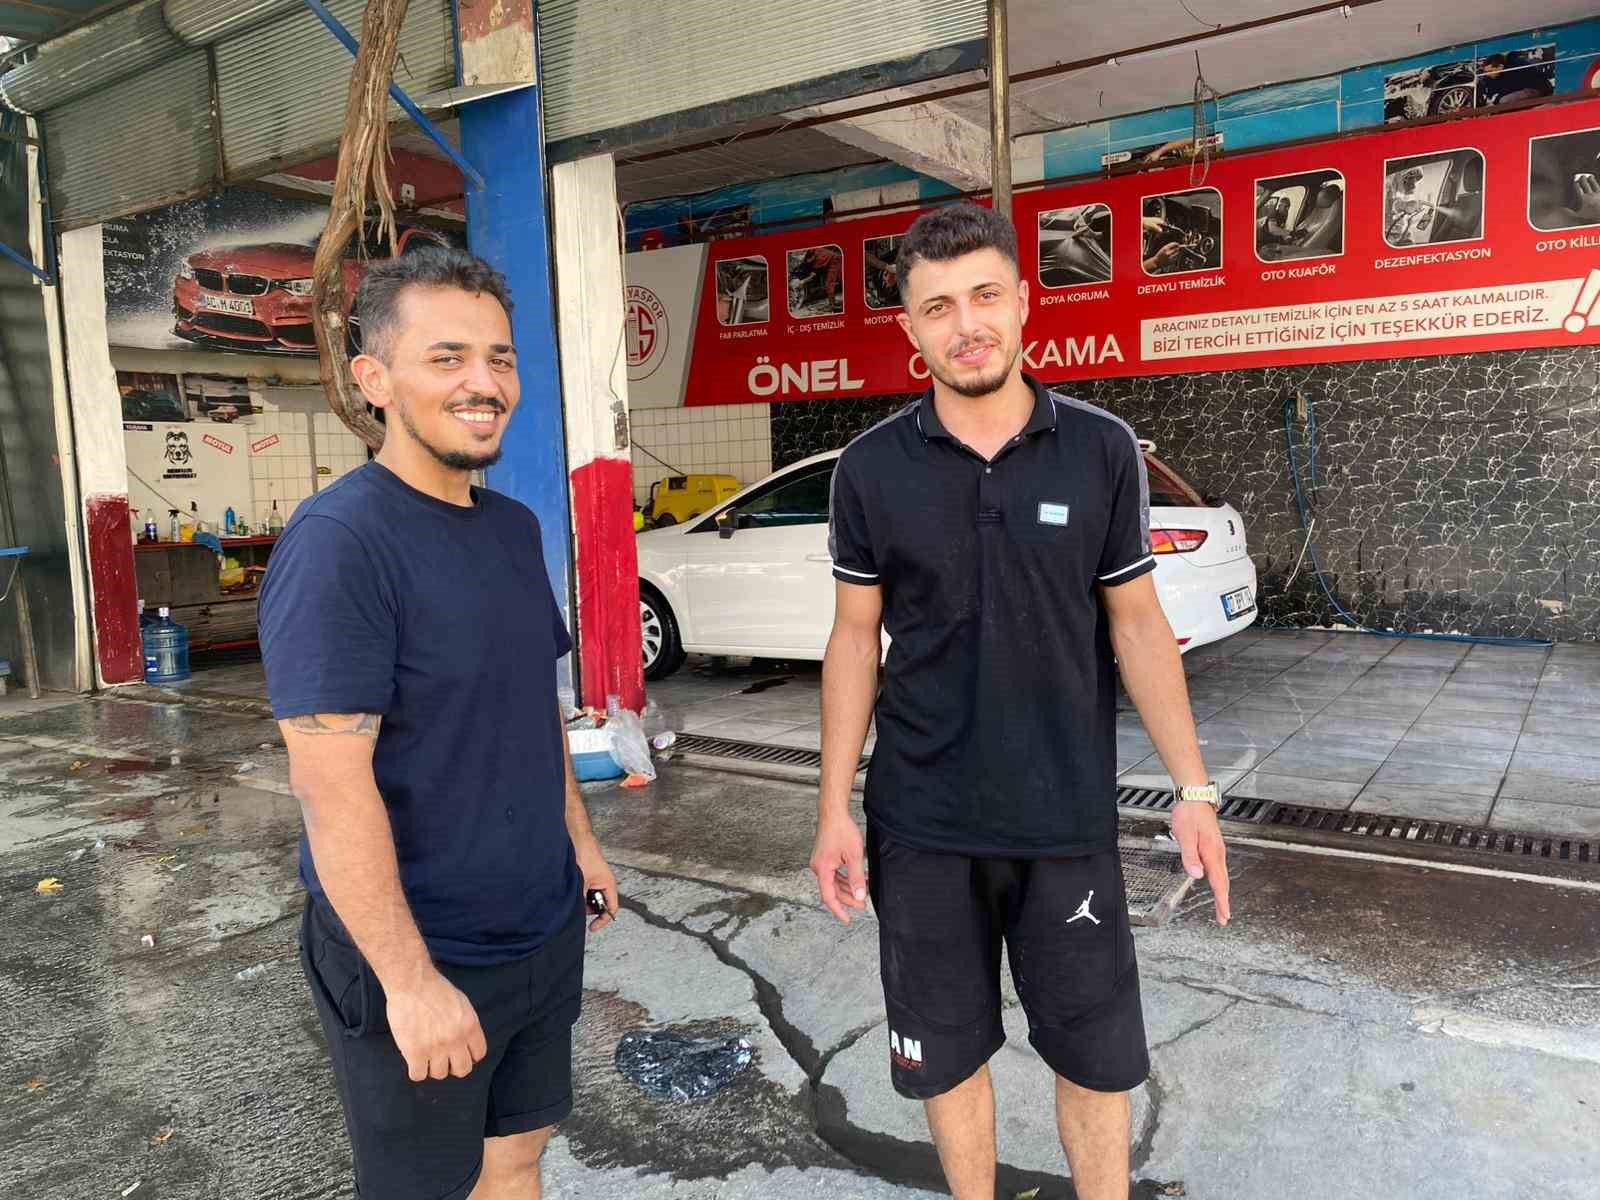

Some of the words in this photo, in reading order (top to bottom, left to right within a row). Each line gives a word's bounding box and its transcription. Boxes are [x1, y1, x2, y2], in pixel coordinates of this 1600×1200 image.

[1536, 239, 1566, 252] OTO
[1570, 235, 1600, 248] KİLL
[103, 249, 145, 260] EKTASYON
[1375, 247, 1491, 270] DEZENFEKTASYON
[1261, 270, 1286, 281] OTO
[1288, 263, 1336, 279] KUAFÖR
[1137, 282, 1177, 295] DETAYLI
[1179, 276, 1225, 290] TEMİZLİK
[625, 287, 664, 320] YASPOR
[1040, 295, 1065, 306] BOYA
[1067, 290, 1110, 303] KORUMA
[864, 314, 894, 326] MOTOR
[1153, 318, 1209, 334] ARACINIZ
[1212, 315, 1260, 328] DETAYLI
[1264, 307, 1320, 323] TEMİZLİK
[1324, 303, 1352, 320] İÇİN
[1356, 303, 1374, 315] EN
[1378, 302, 1396, 313] AZ
[1400, 301, 1408, 311] 5
[1412, 297, 1448, 310] SAAT
[1452, 288, 1549, 306] KALMALIDIR.
[733, 328, 768, 339] PARLATMA
[813, 320, 845, 331] TEMİZLİK
[1153, 336, 1181, 353] BİZİ
[1184, 331, 1240, 351] TERCİH
[1246, 324, 1325, 346] ETTİĞİNİZ
[1330, 321, 1366, 341] İÇİN
[1371, 312, 1467, 337] TEŞEKKÜR
[1473, 307, 1549, 328] EDERİZ.
[748, 356, 865, 396] ÖNEL
[1020, 333, 1125, 369] KAMA
[890, 1029, 922, 1062] AN
